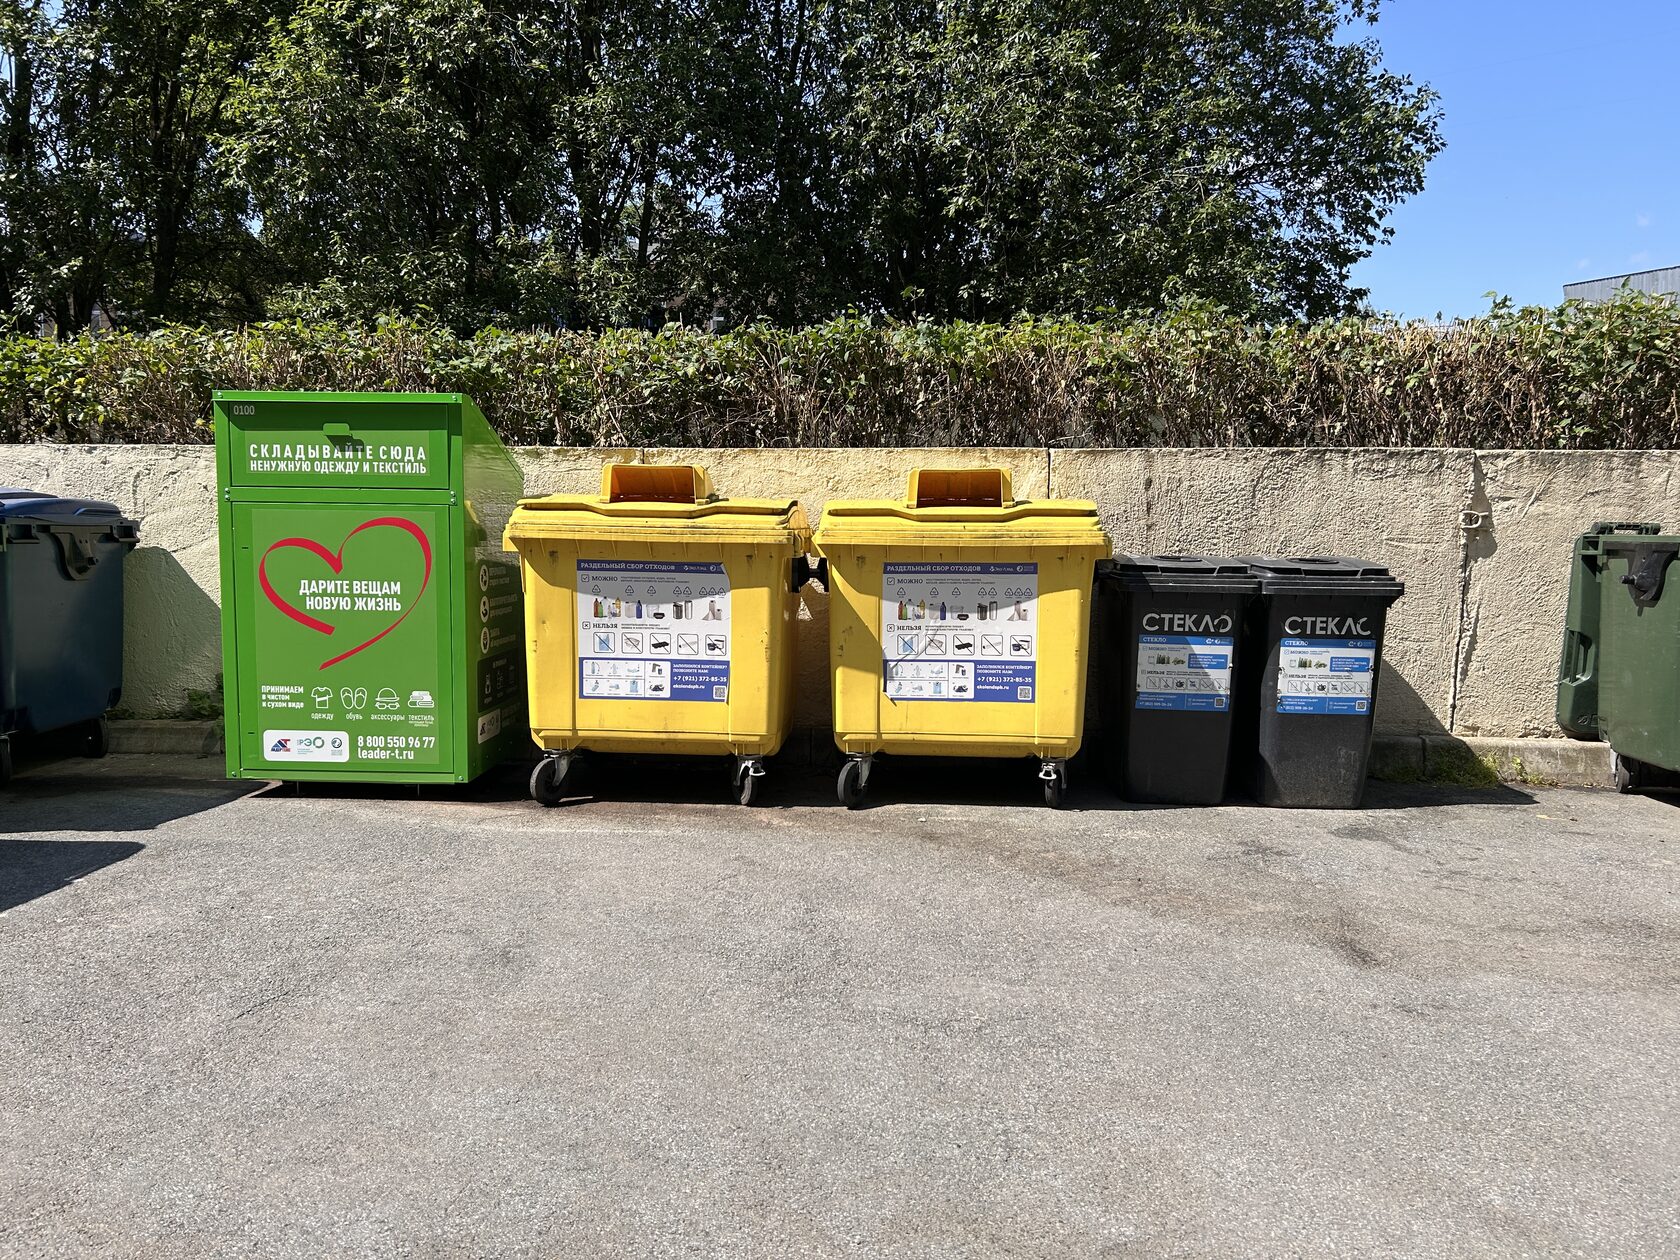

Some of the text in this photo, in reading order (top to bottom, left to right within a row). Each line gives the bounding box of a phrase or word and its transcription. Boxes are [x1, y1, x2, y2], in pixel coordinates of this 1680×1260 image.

[234, 405, 255, 415] 0100
[250, 442, 426, 462] СКЛАДЫВАЙТЕ СЮДА
[250, 460, 426, 474] НЕНУЖНУЮ ОДЕЖДУ И ТЕКСТИЛЬ
[299, 580, 400, 596] ДАРИТЕ ВЕЩАМ
[306, 596, 402, 611] НОВУЮ ЖИЗНЬ
[1142, 613, 1232, 632] СТЕКЛО
[261, 685, 304, 693] ПРИНИМАЕМ
[346, 712, 363, 720] обувь
[357, 736, 435, 748] 8 800 550 96 77
[358, 748, 414, 759] leader-t.ru
